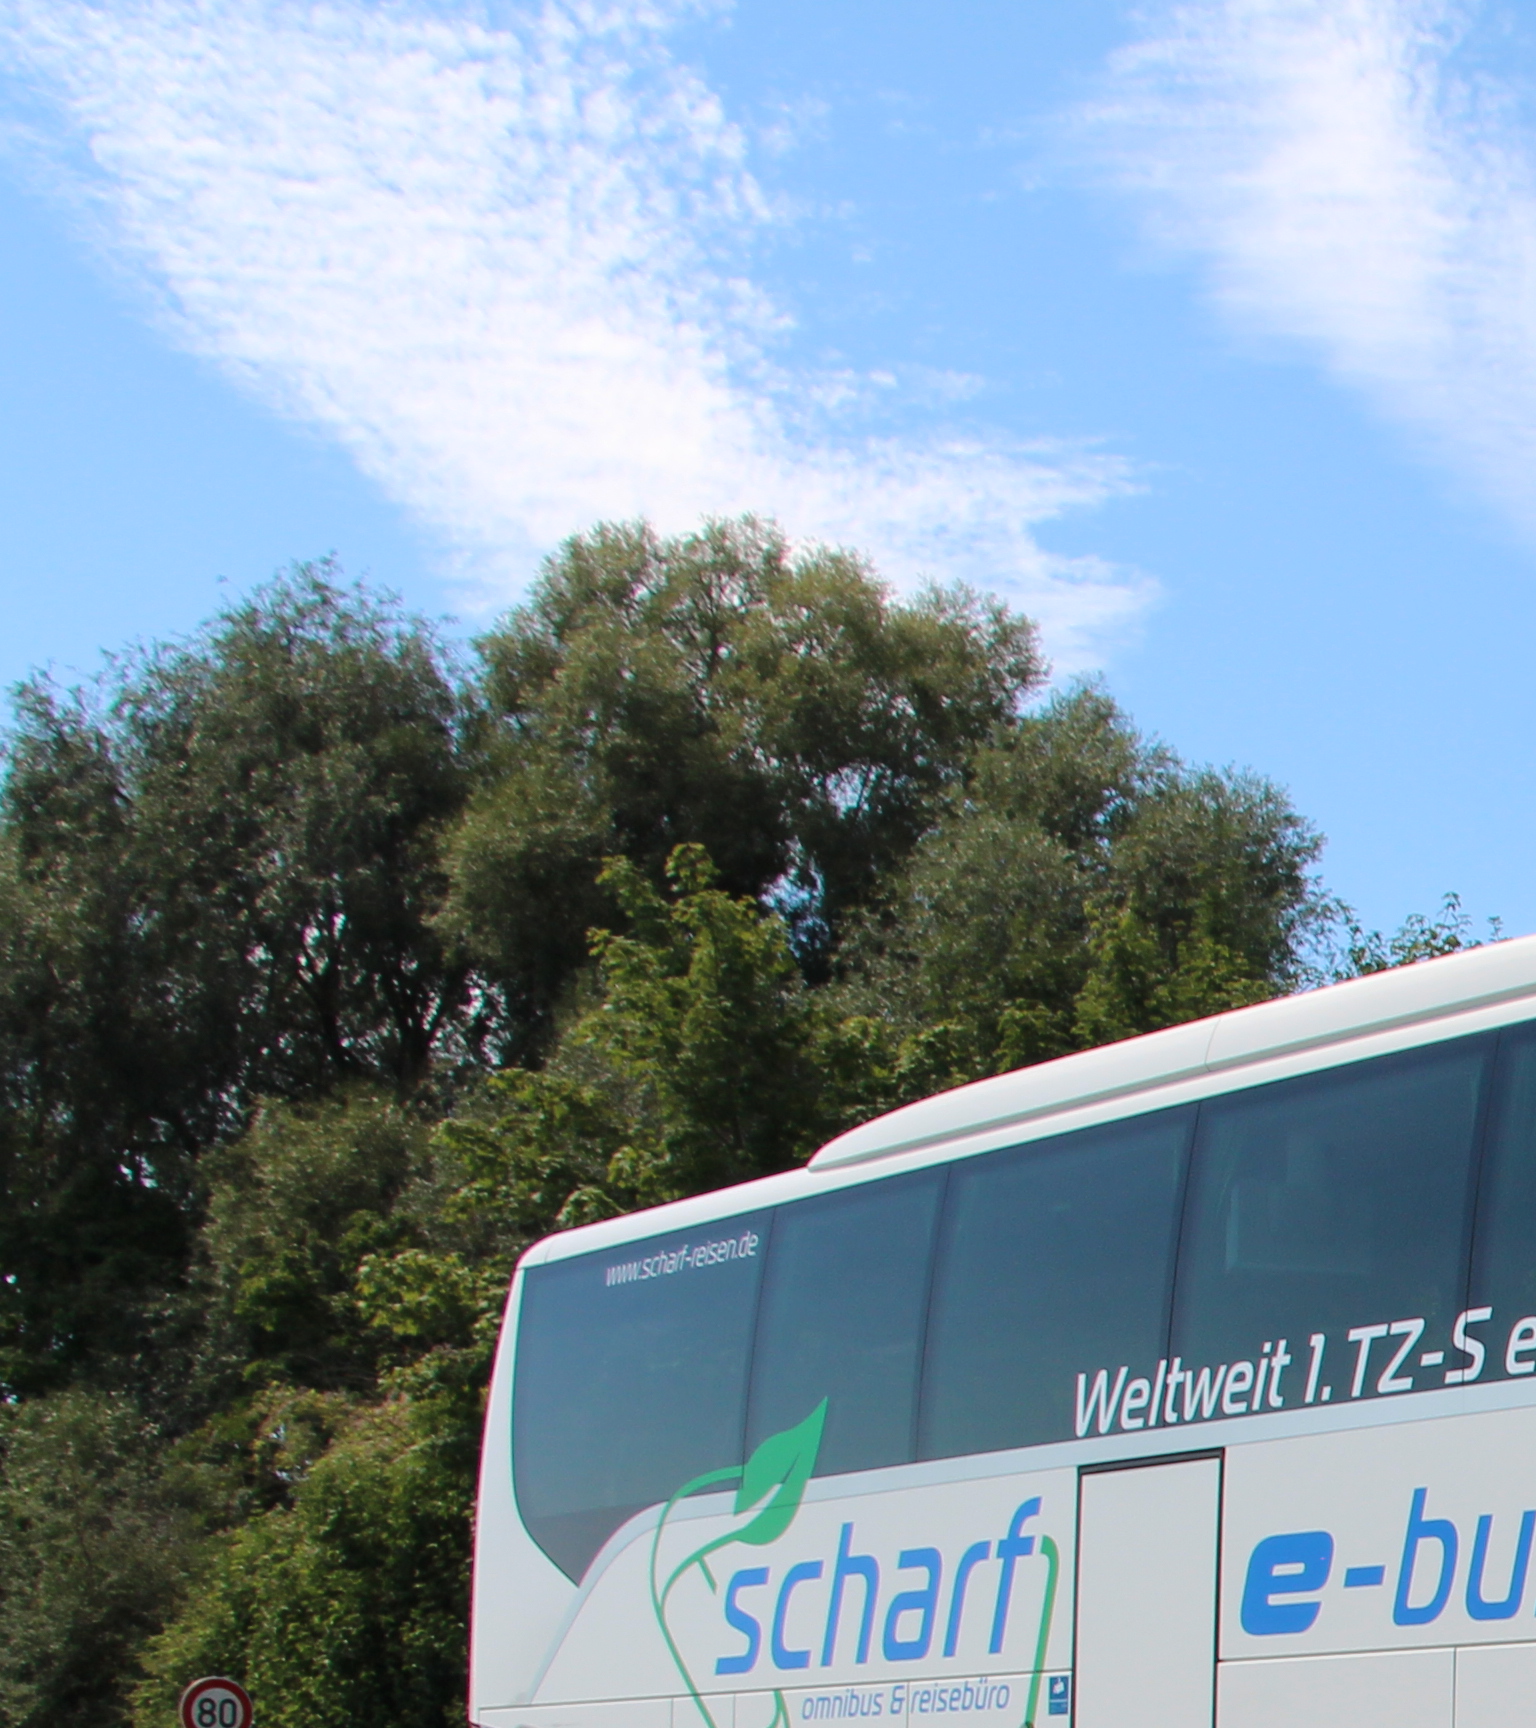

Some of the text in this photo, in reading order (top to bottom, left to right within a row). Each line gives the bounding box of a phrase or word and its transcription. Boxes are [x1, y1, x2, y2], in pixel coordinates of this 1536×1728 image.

[605, 1230, 759, 1287] www.scharf-reisen.de
[1073, 1339, 1291, 1438] Weltweit
[1304, 1332, 1332, 1404] 1.
[1347, 1306, 1493, 1398] TZ-S
[714, 1496, 1043, 1676] scharf
[198, 1697, 238, 1728] 80
[801, 1676, 1011, 1721] omnibus & reisebüro
